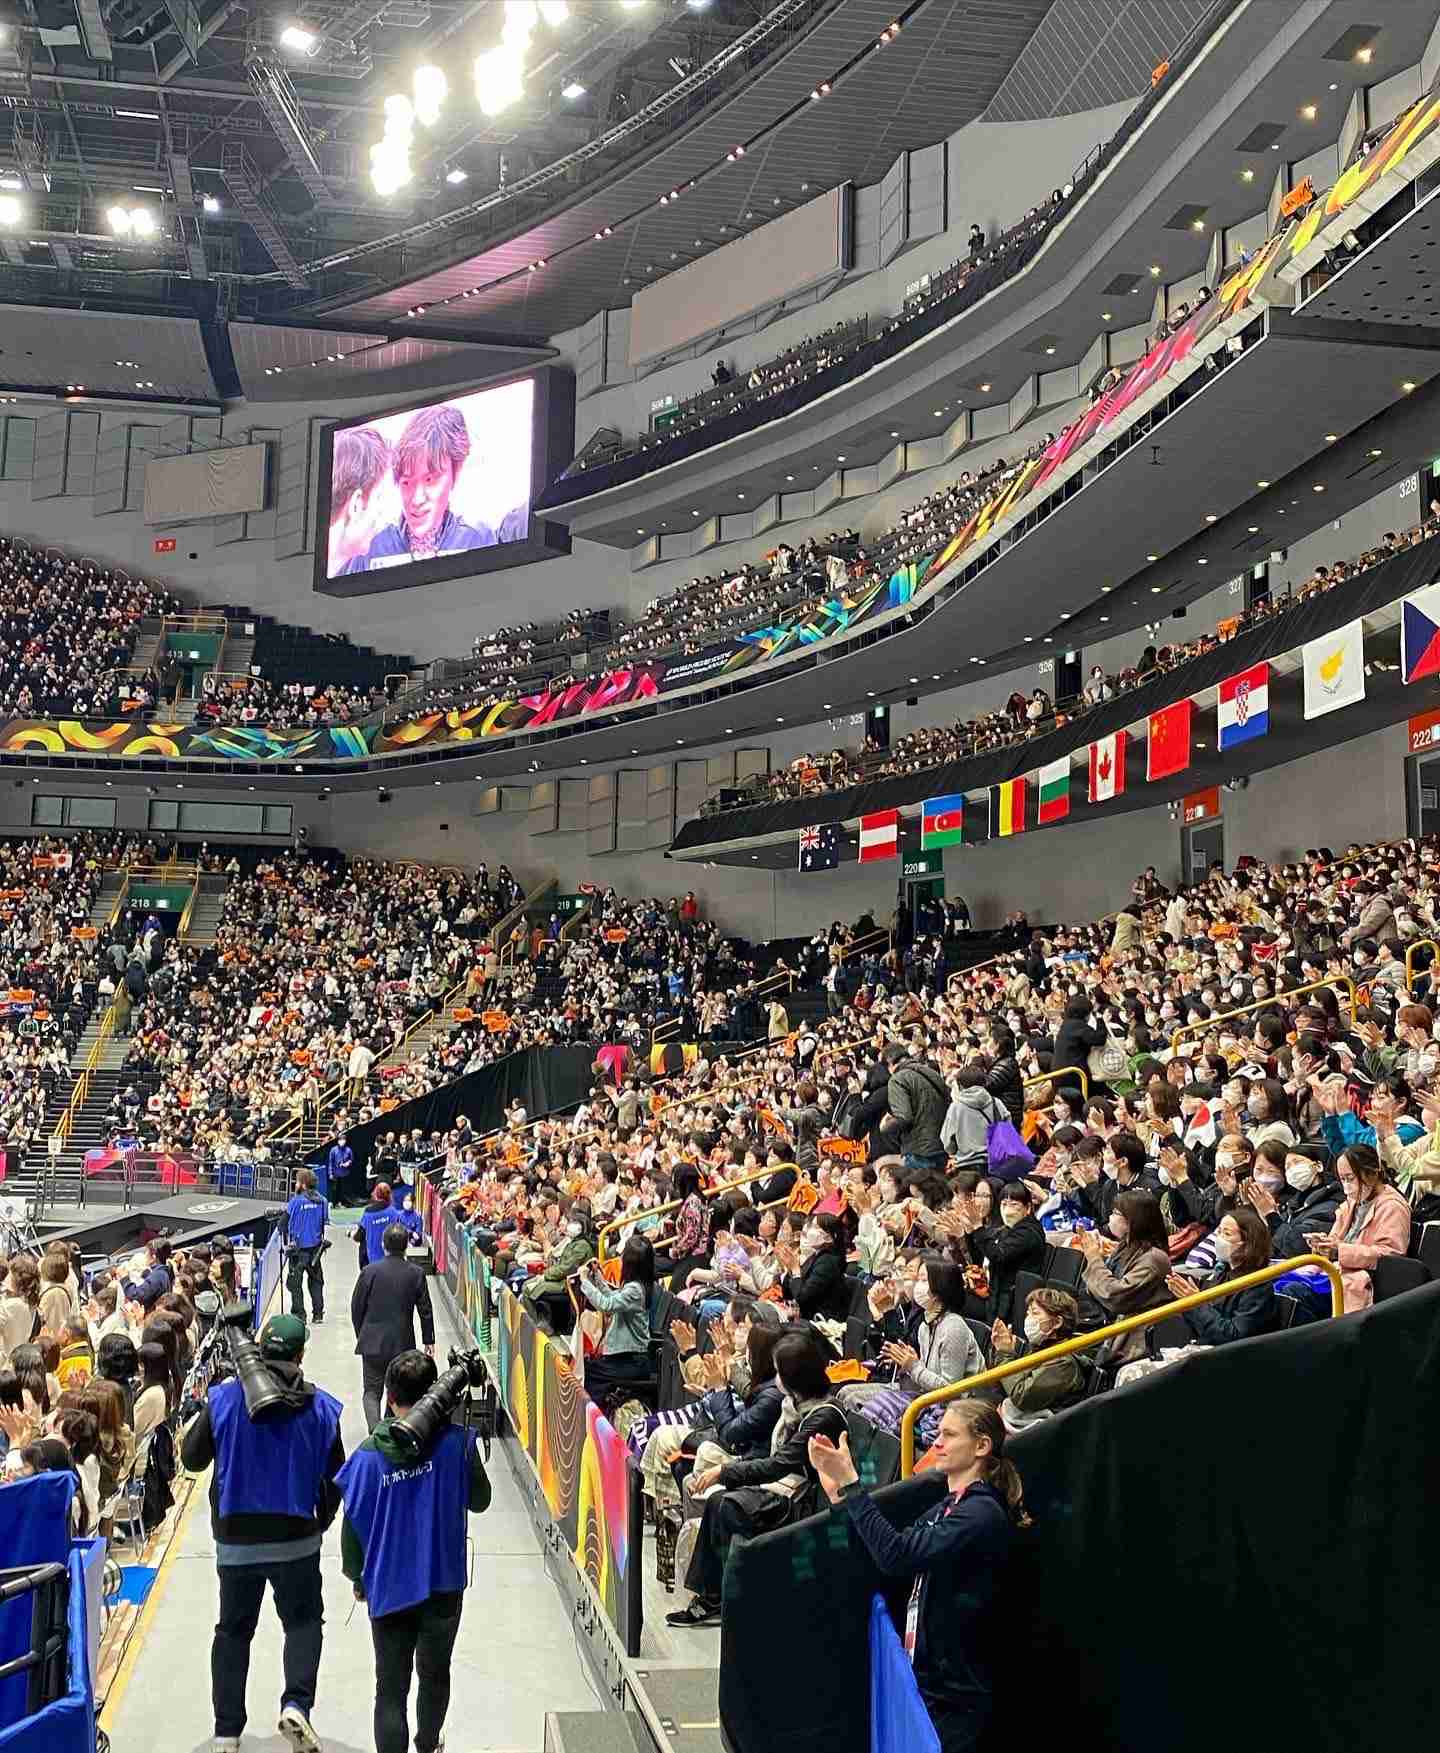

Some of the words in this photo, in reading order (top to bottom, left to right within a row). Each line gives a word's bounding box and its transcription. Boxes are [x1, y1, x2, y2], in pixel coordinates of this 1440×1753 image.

[1399, 475, 1417, 499] 328
[1038, 659, 1053, 674] 326
[1412, 728, 1432, 749] 222
[904, 863, 918, 874] 220
[131, 898, 151, 909] 218
